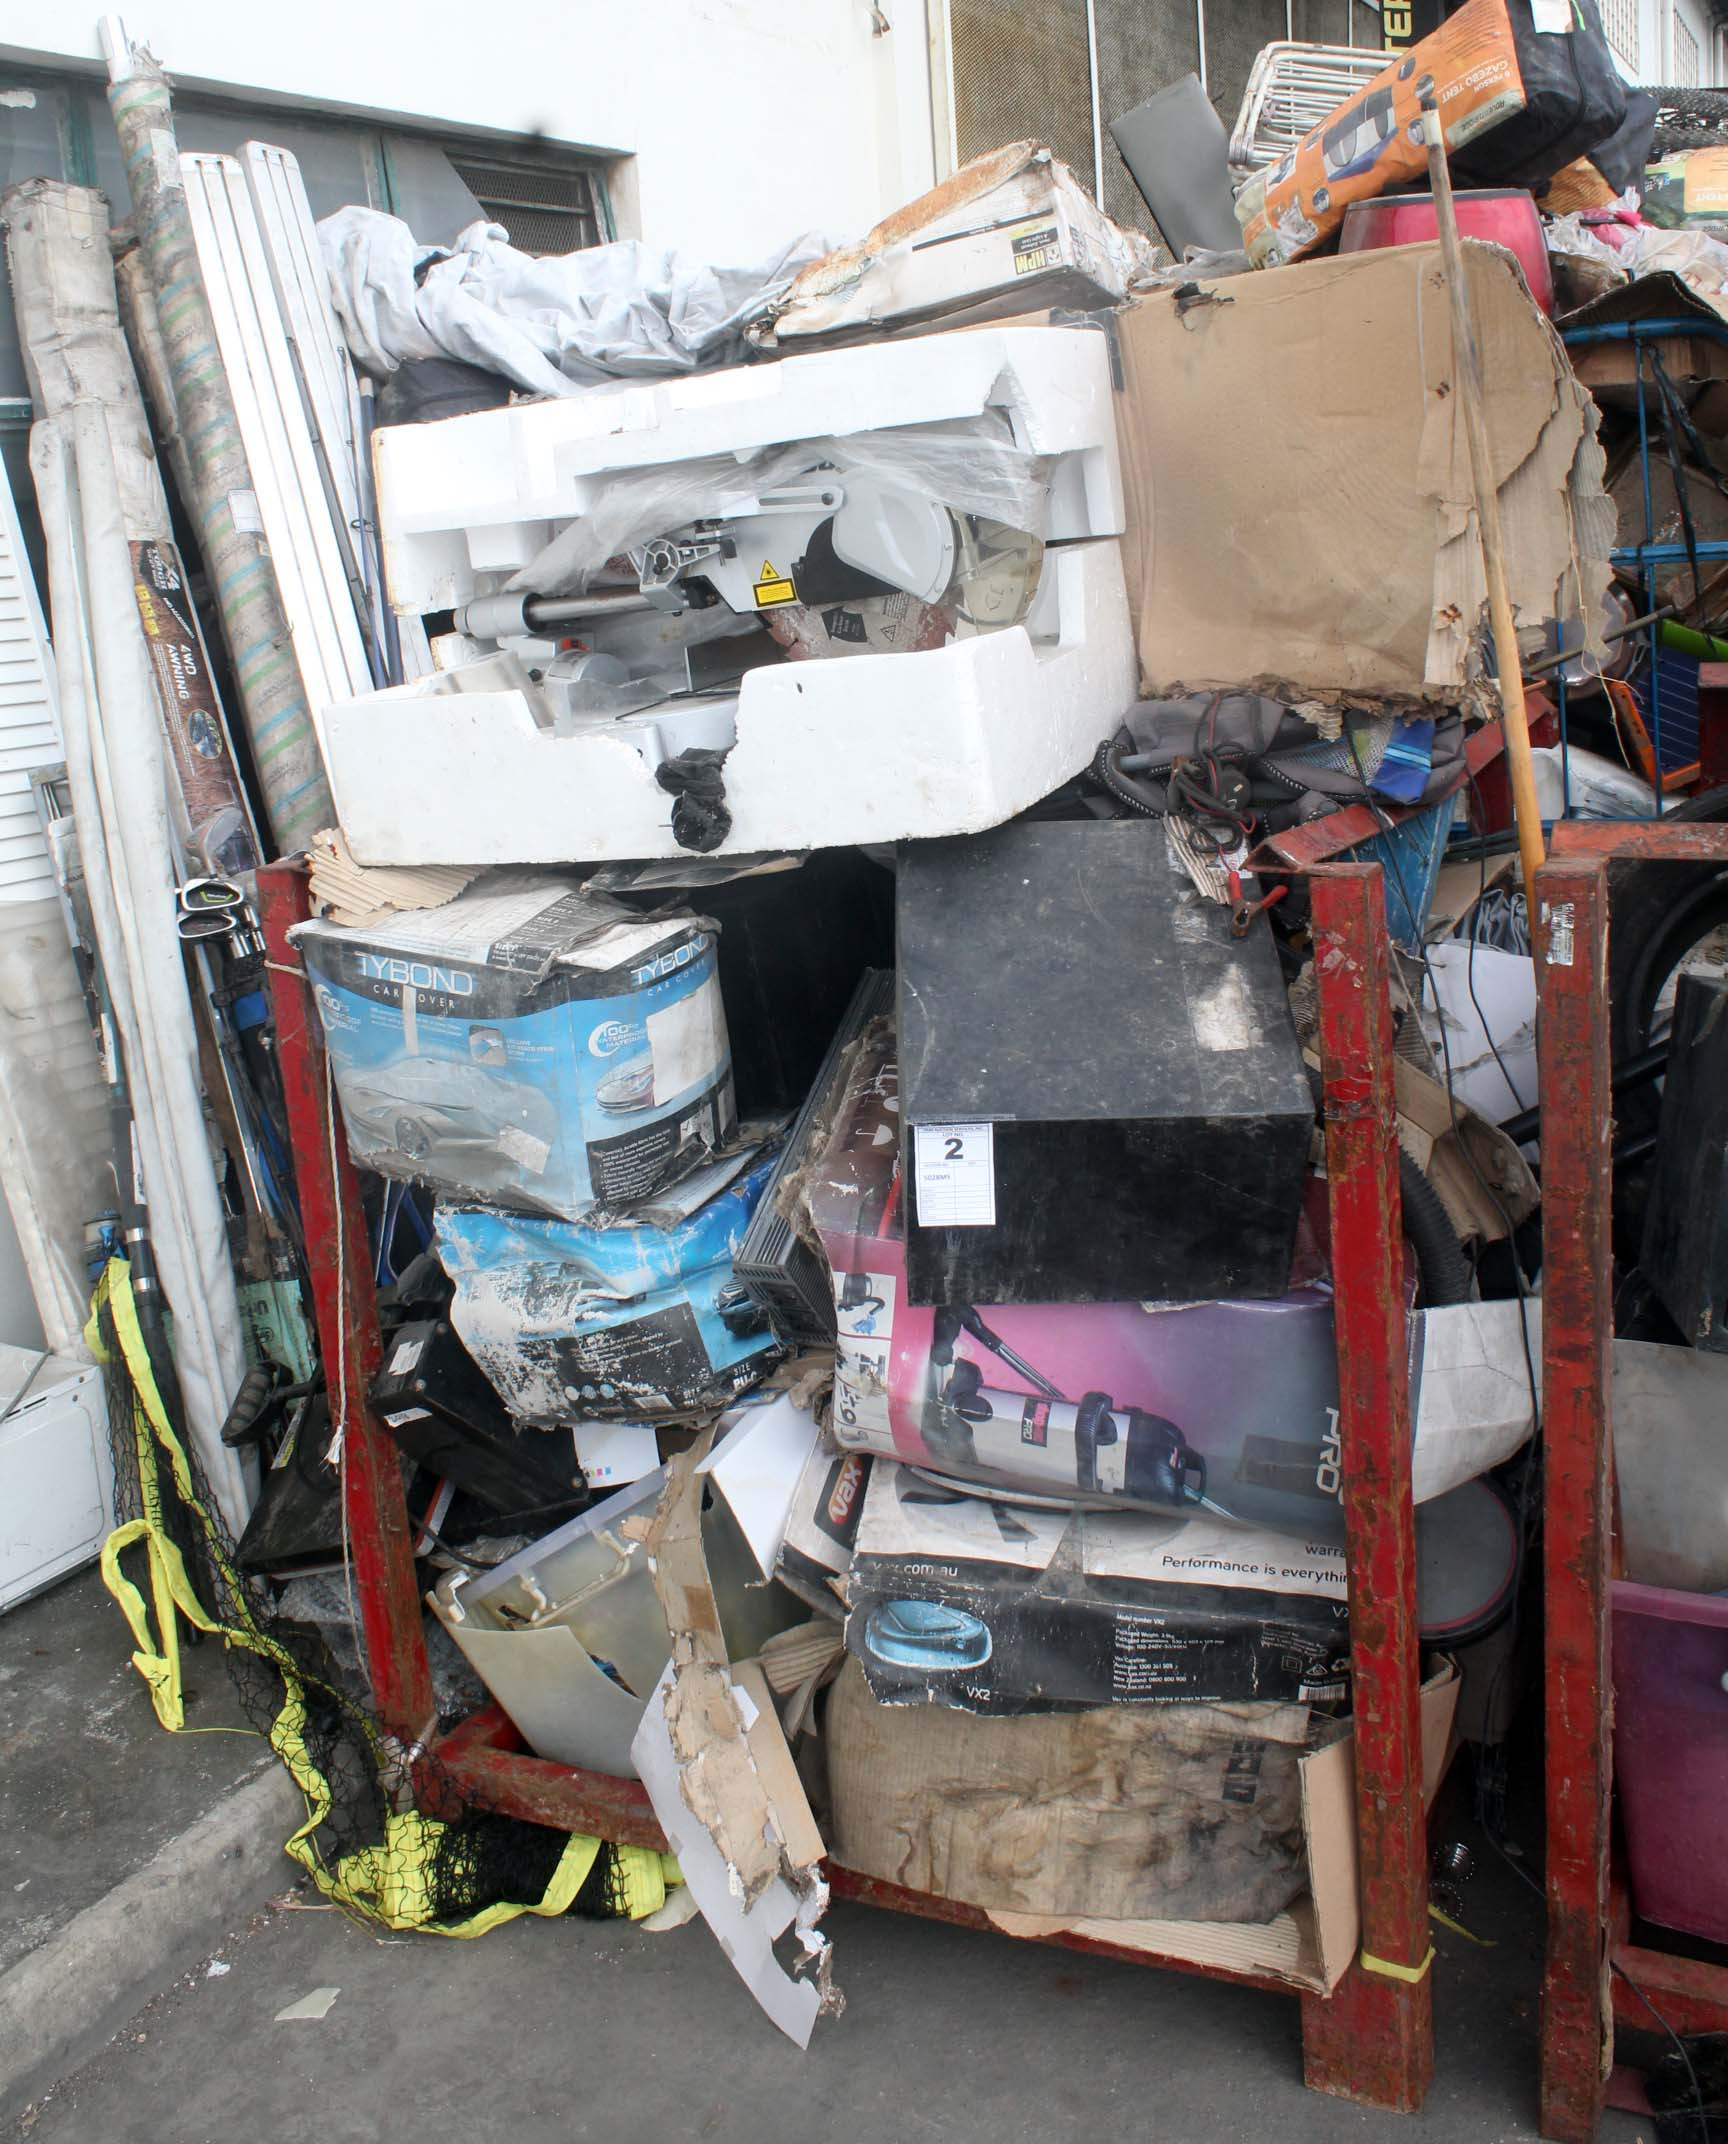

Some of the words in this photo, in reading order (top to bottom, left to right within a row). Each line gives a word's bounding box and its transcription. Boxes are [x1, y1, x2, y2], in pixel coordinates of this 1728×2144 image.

[1441, 83, 1464, 104] TENT
[166, 643, 190, 700] AWNING
[630, 933, 709, 985] TYBOND
[353, 950, 473, 995] TYBOND
[373, 984, 400, 998] CAR
[405, 990, 455, 1009] OVER
[647, 980, 671, 997] CAR
[944, 1138, 964, 1160] 2
[733, 1362, 751, 1376] SIZE
[1317, 1407, 1341, 1493] PRO
[832, 1462, 862, 1515] vax
[1163, 1555, 1258, 1573] Performance
[1264, 1563, 1276, 1575] is
[967, 1685, 990, 1701] VX2
